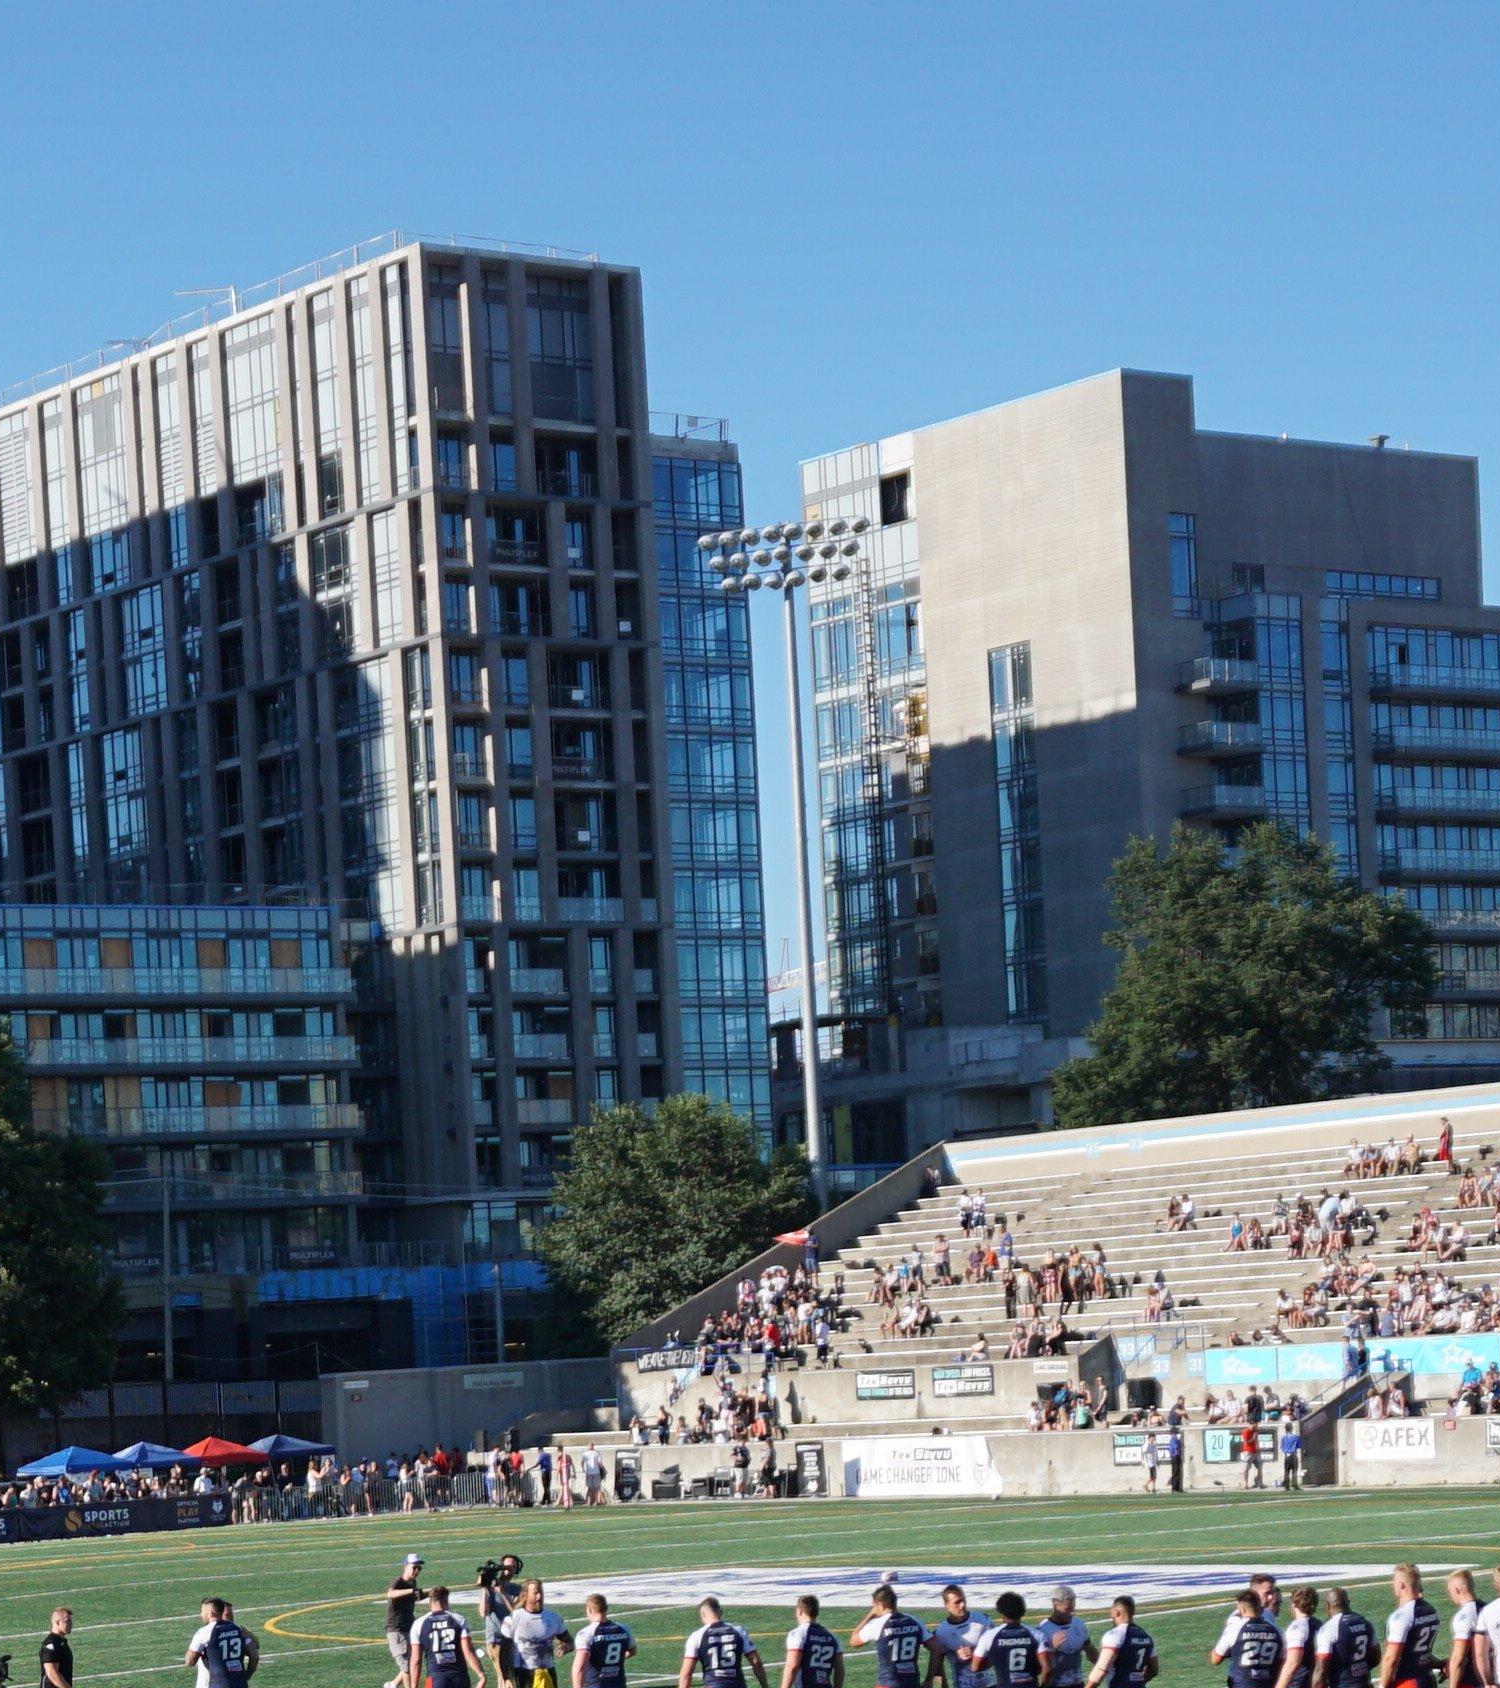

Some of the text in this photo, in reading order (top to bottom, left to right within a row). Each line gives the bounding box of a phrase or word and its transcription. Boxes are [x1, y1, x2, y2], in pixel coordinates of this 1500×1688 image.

[1152, 1359, 1170, 1373] 33
[1211, 1434, 1224, 1450] 20
[886, 1466, 932, 1484] CHANGER
[936, 1465, 962, 1482] ZONE
[84, 1508, 130, 1523] SPORTS
[177, 1507, 199, 1517] PLAY
[219, 1637, 242, 1660] 13
[429, 1628, 456, 1652] 12
[887, 1635, 918, 1662] 18
[997, 1637, 1032, 1647] THOMAS
[1353, 1635, 1368, 1661] 3
[1414, 1624, 1440, 1652] 27
[604, 1642, 621, 1664] 8
[707, 1643, 738, 1670] 15
[809, 1644, 835, 1668] 22
[1009, 1647, 1027, 1671] 6
[1135, 1647, 1147, 1670] 1
[1241, 1641, 1278, 1666] 29
